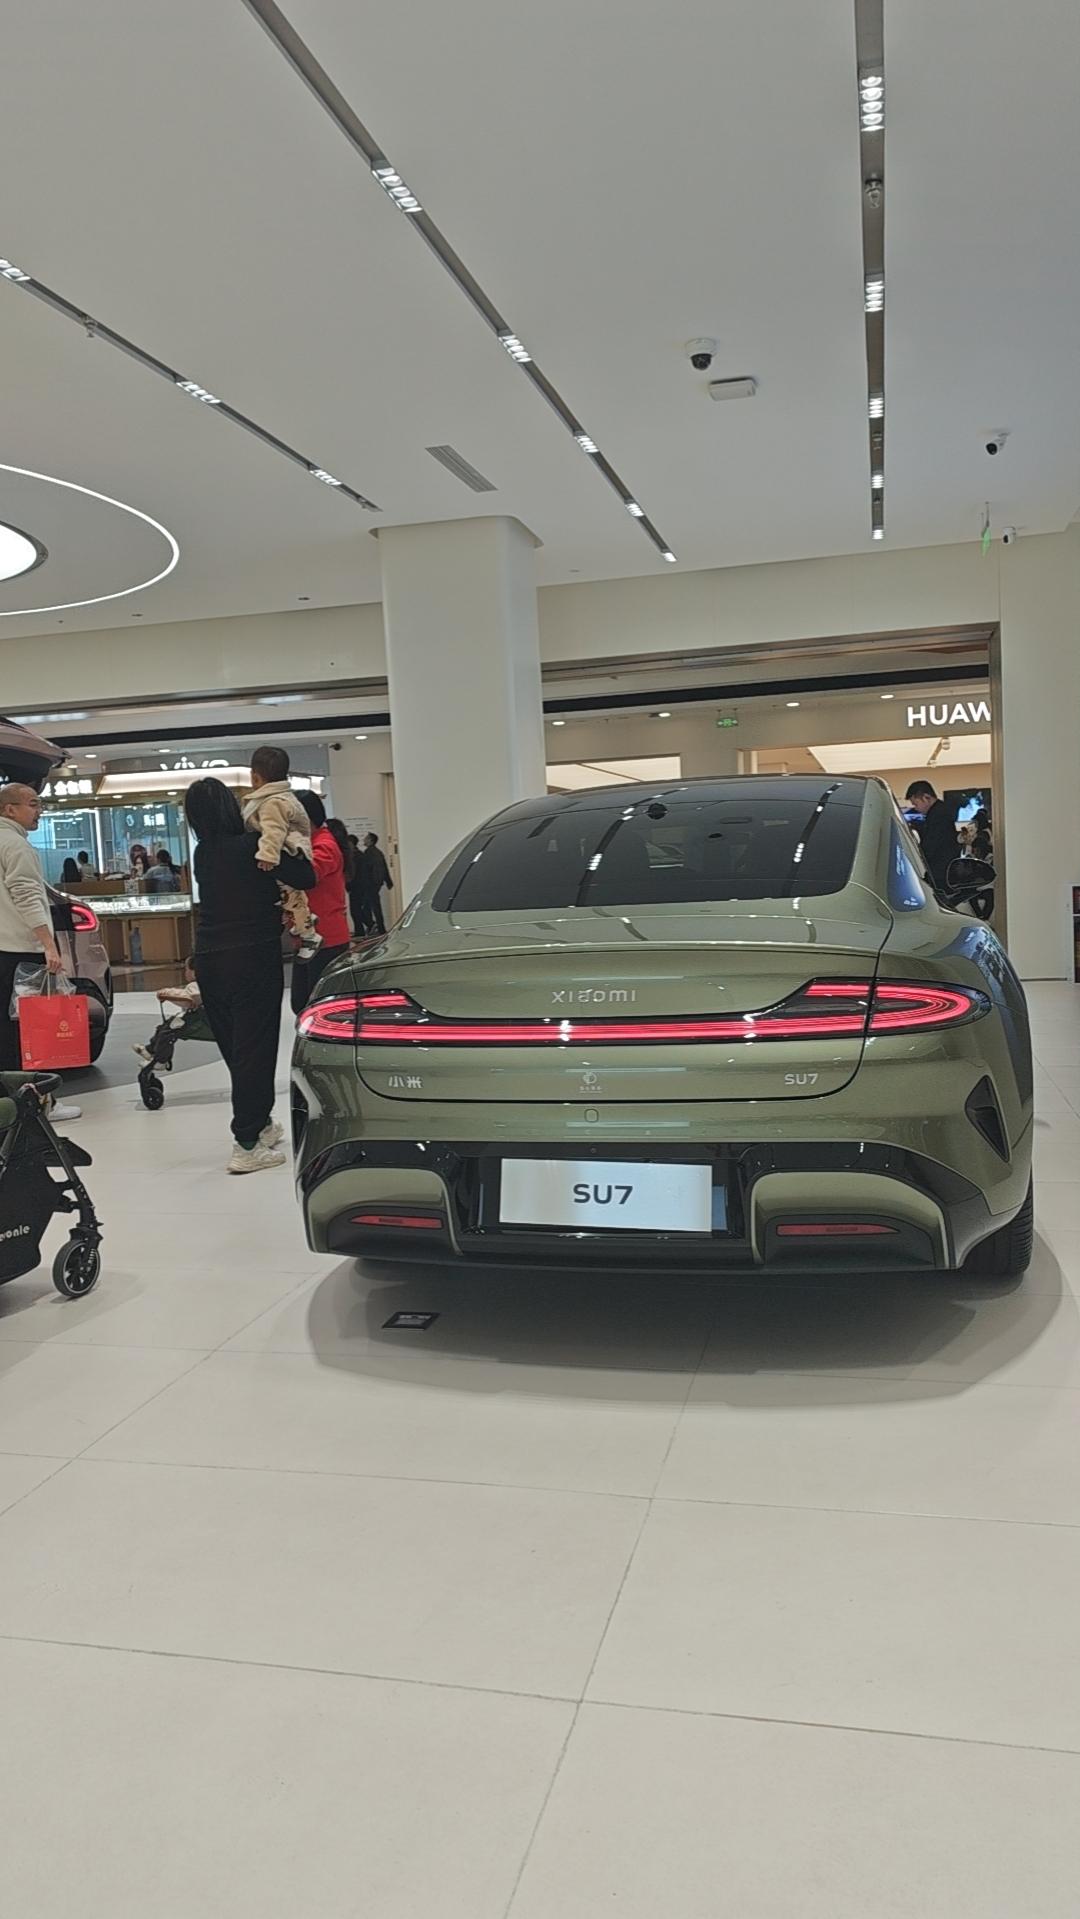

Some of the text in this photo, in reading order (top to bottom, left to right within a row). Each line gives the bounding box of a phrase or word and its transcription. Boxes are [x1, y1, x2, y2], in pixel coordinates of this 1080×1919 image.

[907, 701, 992, 727] HUAW
[551, 988, 636, 1003] xiaomi
[388, 1075, 423, 1089] 小米
[784, 1072, 819, 1085] SU7
[573, 1183, 633, 1205] SU7
